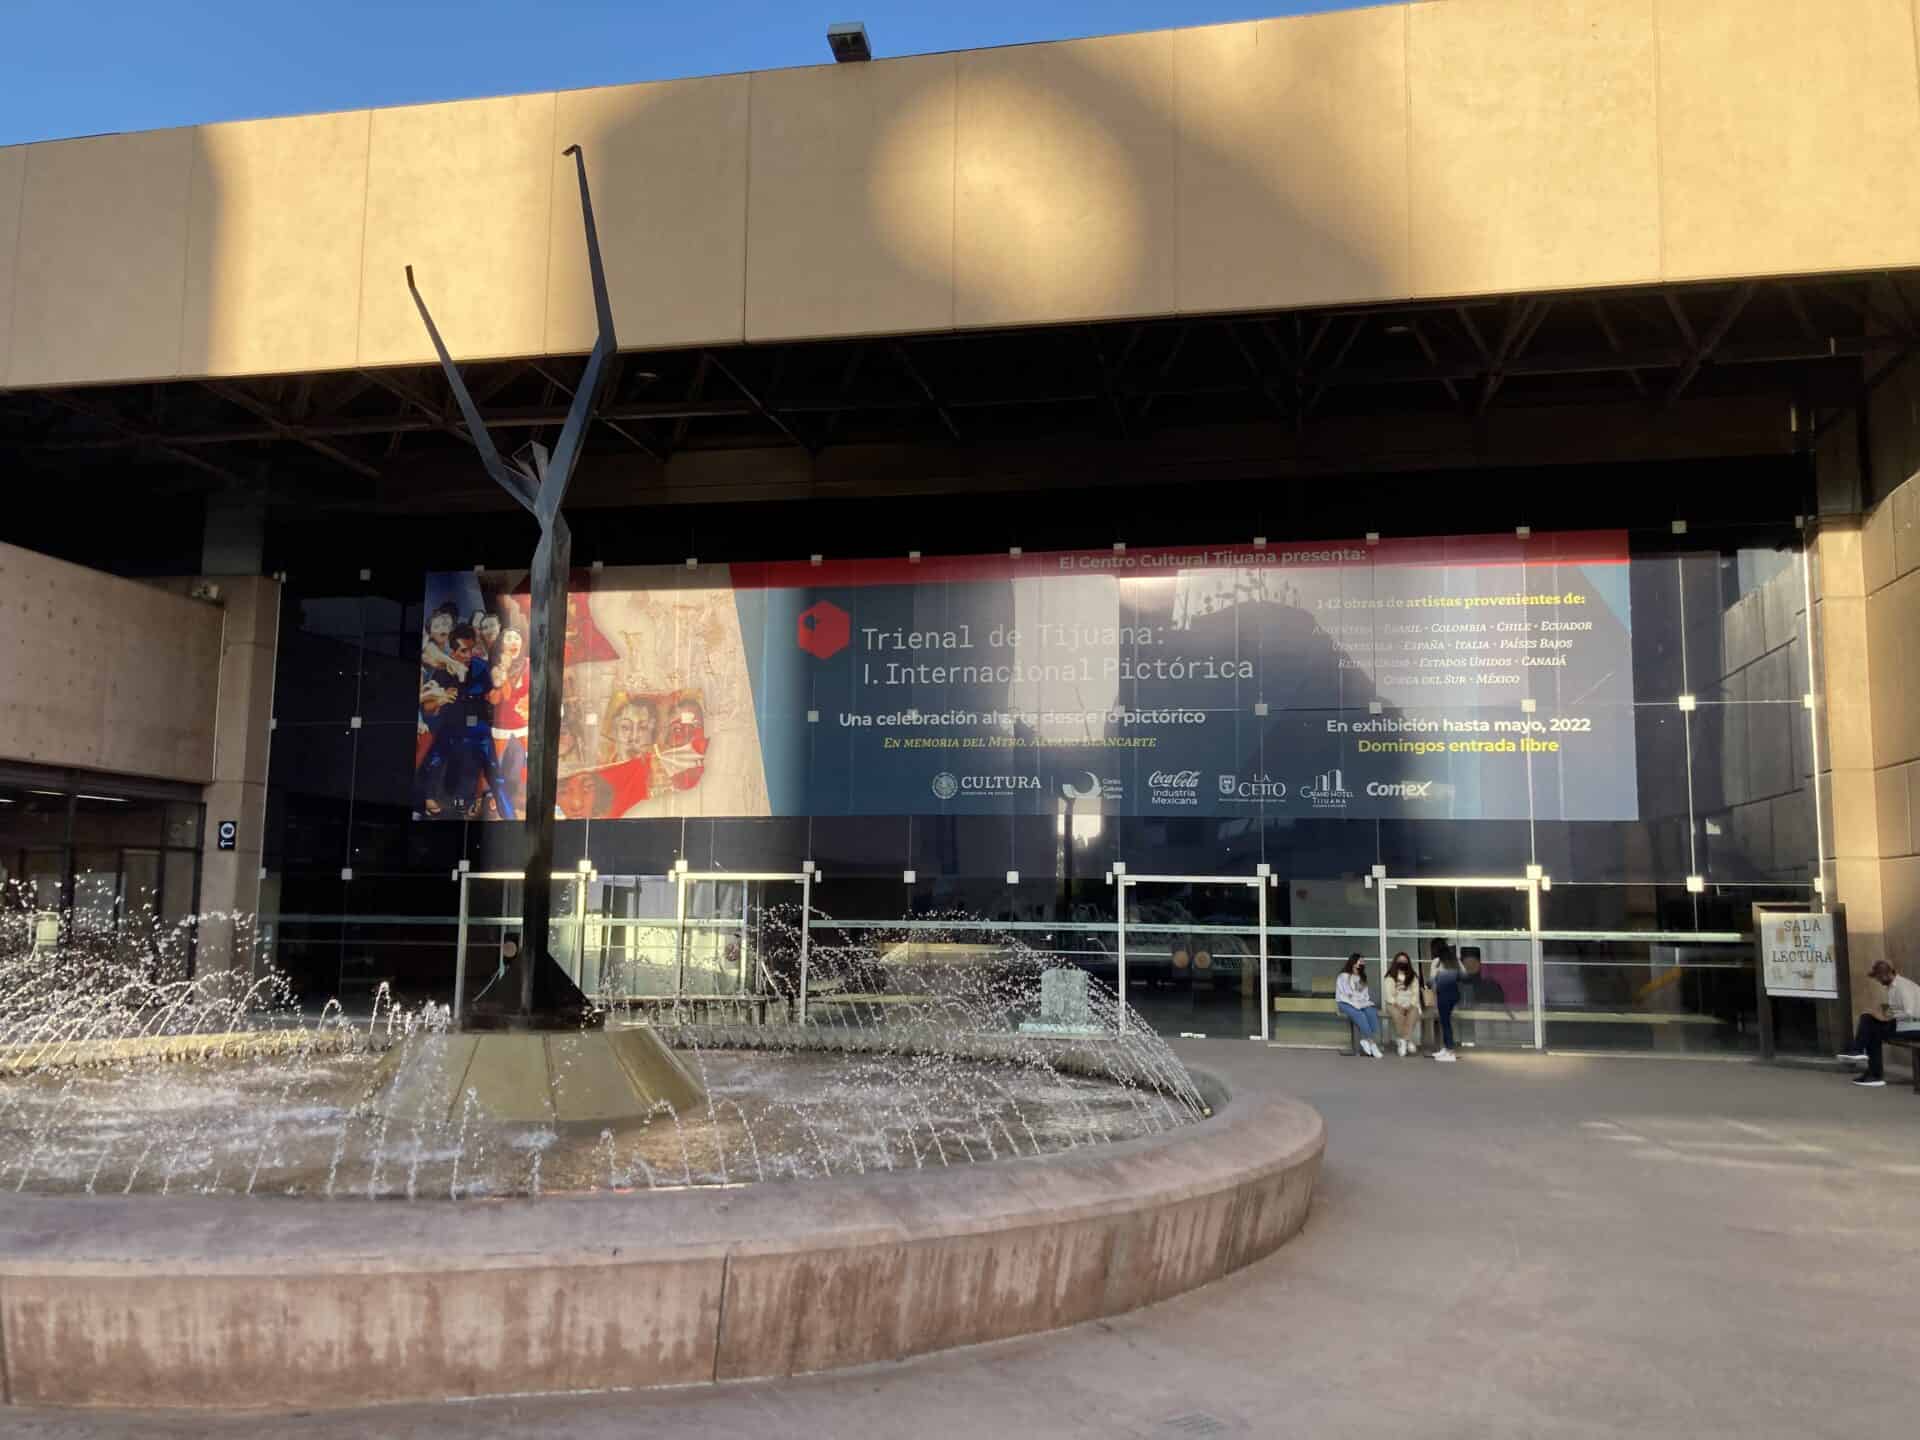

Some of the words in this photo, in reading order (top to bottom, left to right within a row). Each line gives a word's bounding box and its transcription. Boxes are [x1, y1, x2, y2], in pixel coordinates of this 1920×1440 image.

[1059, 555, 1075, 570] El
[1080, 554, 1135, 569] Centro
[1140, 551, 1209, 568] Cultural
[1213, 551, 1277, 567] Tijuana
[1281, 548, 1367, 565] presenta:
[1406, 594, 1461, 609] artistas
[1464, 593, 1561, 609] provenientes
[1563, 592, 1586, 606] de:
[1431, 622, 1487, 633] COLOMBIA
[1496, 621, 1531, 632] CHILE
[1541, 620, 1593, 631] ECUADOR
[861, 625, 975, 651] Trienal
[988, 623, 1022, 648] de
[1038, 623, 1165, 653] Tijuana:
[1455, 639, 1489, 650] ITALIA
[1539, 638, 1573, 650] BAJOS
[1102, 655, 1254, 681] Pictórica
[839, 712, 873, 727] Una
[876, 709, 978, 726] celebración
[1123, 708, 1206, 728] pictórico
[1327, 719, 1349, 733] En
[1351, 718, 1439, 733] exhibición
[1442, 718, 1490, 733] hasta
[1494, 719, 1547, 736] mayo,
[1549, 718, 1591, 732] 2022
[1358, 739, 1446, 755] Domingos
[1449, 738, 1517, 753] entrada
[1519, 738, 1560, 753] libre
[960, 775, 1042, 790] CULTURA
[1252, 773, 1271, 783] LA
[1366, 780, 1433, 798] Comex
[1783, 919, 1822, 933] SALA
[1793, 935, 1811, 948] DE
[1771, 950, 1834, 963] LECTURA
